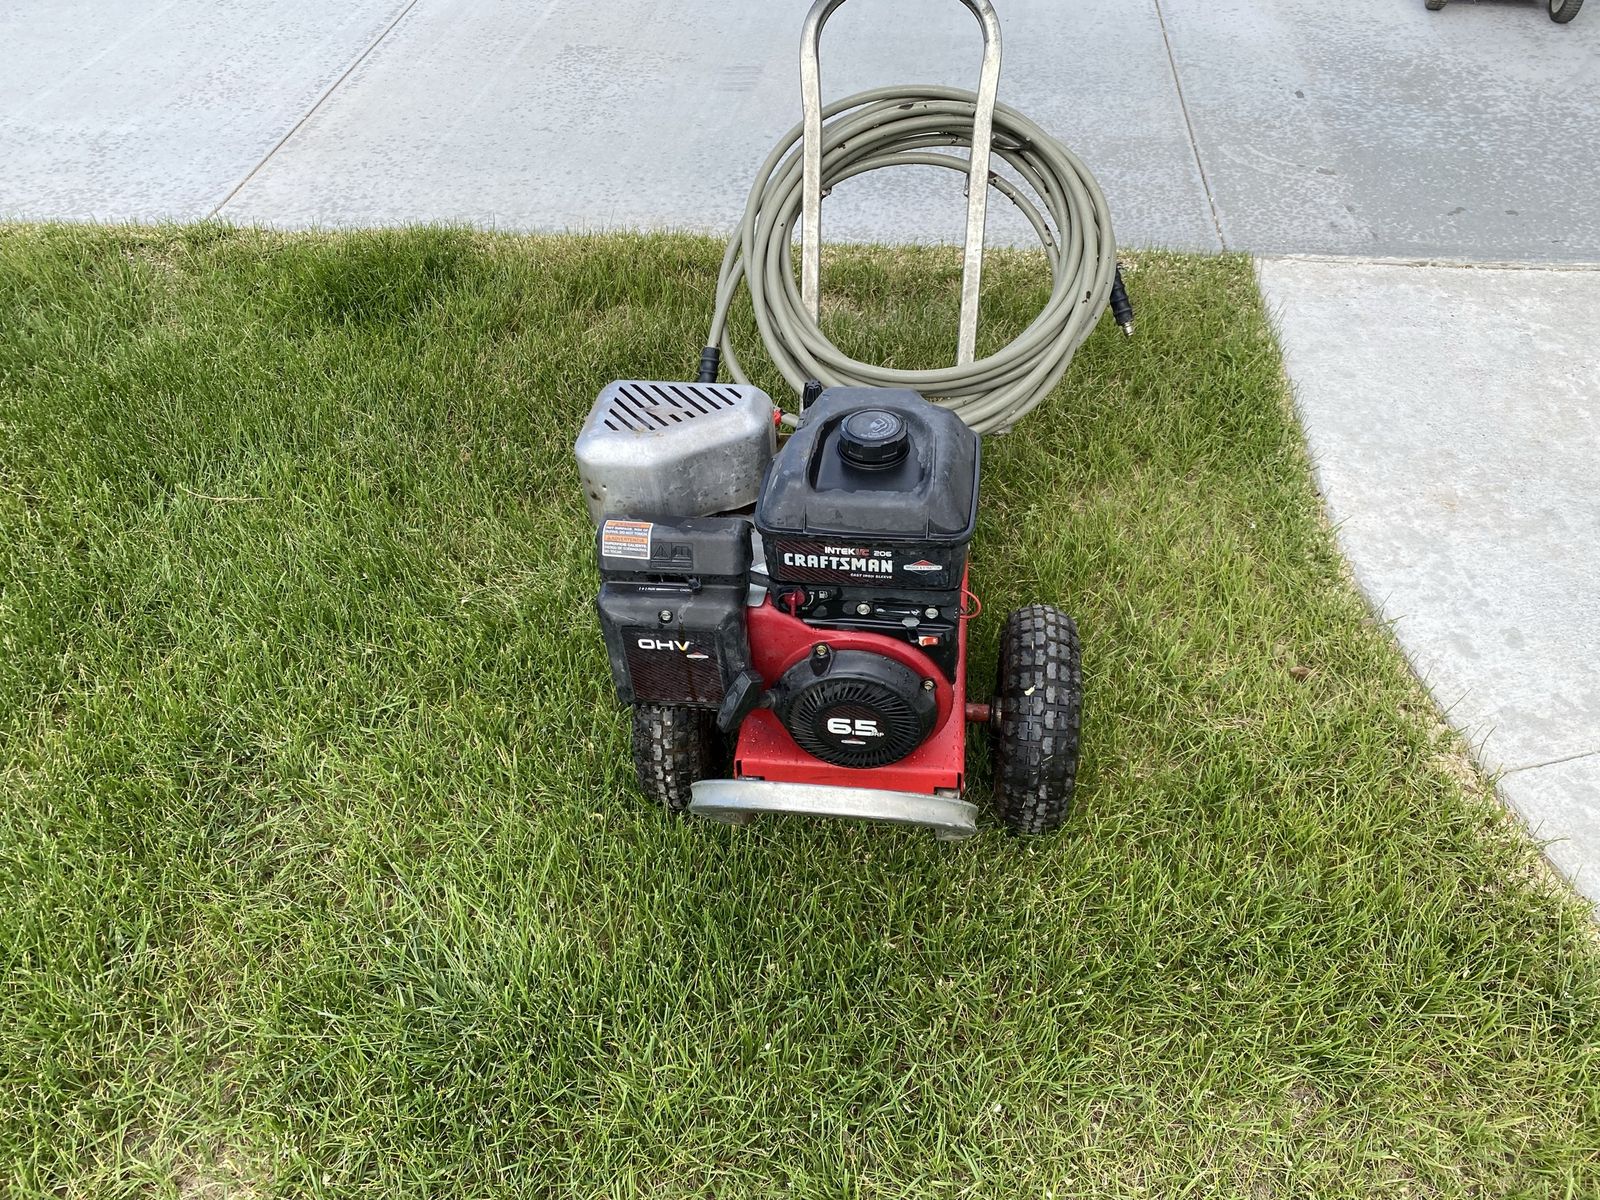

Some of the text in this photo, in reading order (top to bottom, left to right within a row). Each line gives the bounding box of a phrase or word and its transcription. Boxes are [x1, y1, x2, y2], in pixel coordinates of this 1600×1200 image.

[824, 546, 856, 555] INTEK
[783, 553, 893, 573] CRAFTSMAN
[638, 638, 690, 651] OHV
[827, 717, 878, 737] 6.5
